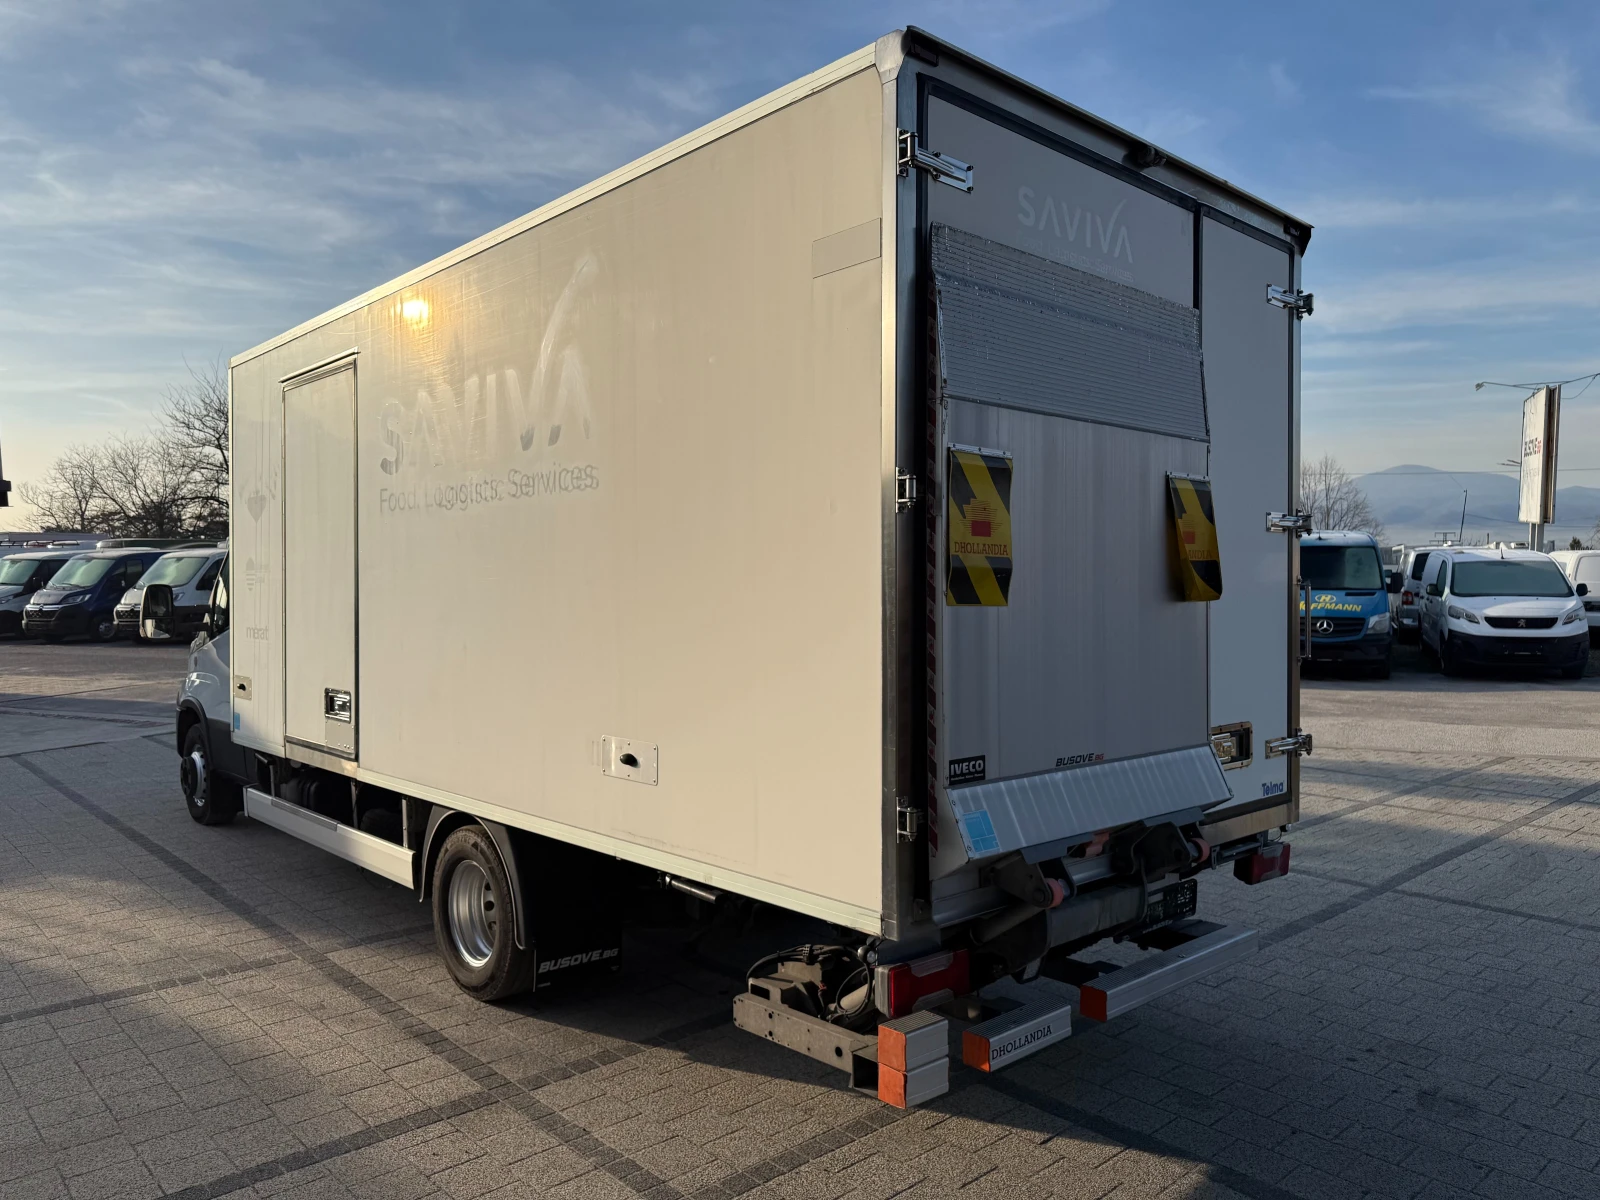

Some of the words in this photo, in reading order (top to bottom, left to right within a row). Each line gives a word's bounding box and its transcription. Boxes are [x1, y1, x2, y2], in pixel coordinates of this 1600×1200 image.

[1017, 185, 1133, 264] SAVIVA
[954, 541, 1008, 556] DHOLLANDIA
[951, 760, 983, 776] IVECO
[1262, 781, 1283, 796] Telma
[991, 1024, 1052, 1060] DHOLLANDIA
